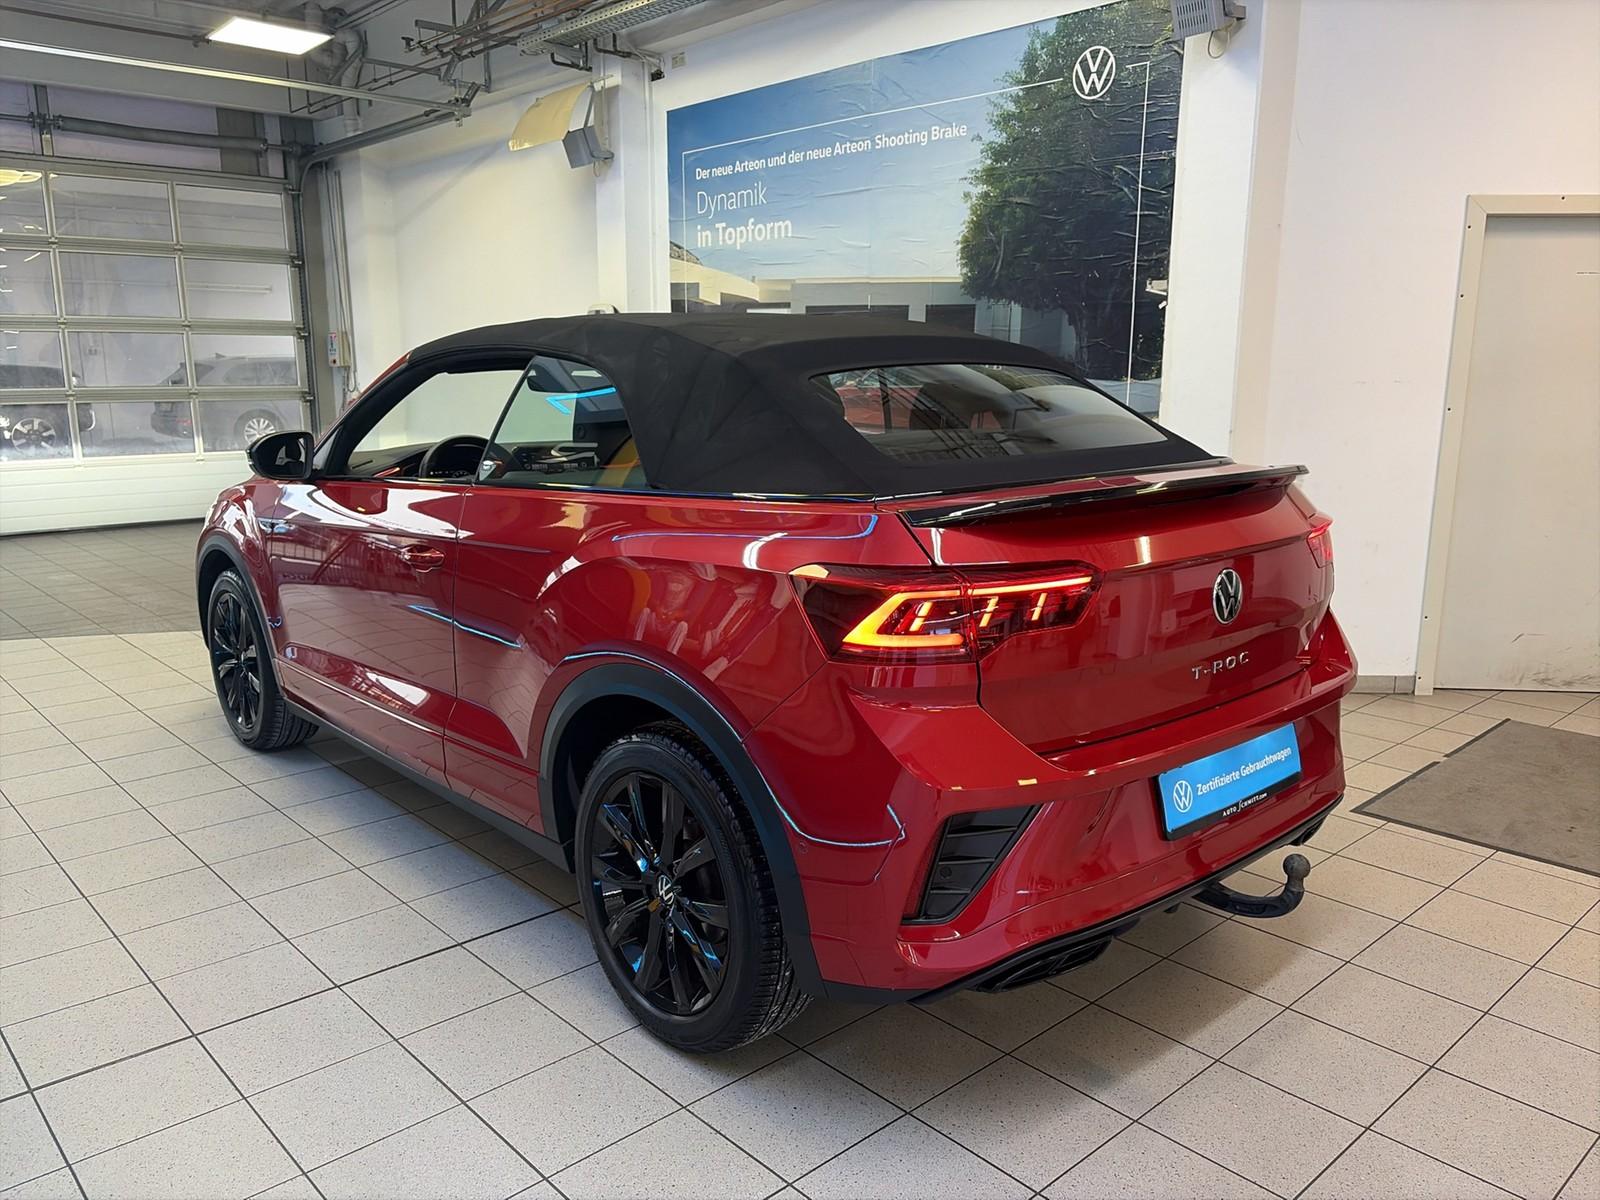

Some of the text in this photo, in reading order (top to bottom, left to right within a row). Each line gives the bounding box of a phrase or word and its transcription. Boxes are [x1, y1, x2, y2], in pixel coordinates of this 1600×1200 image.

[695, 122, 967, 180] Der neue Arteon und der neue Arteon Shooting Brake
[697, 181, 767, 219] Dynamik
[697, 218, 792, 250] in Topform
[1192, 651, 1249, 680] T-ROC
[1196, 747, 1292, 796] Zertifizierte Gebrauchtwagen
